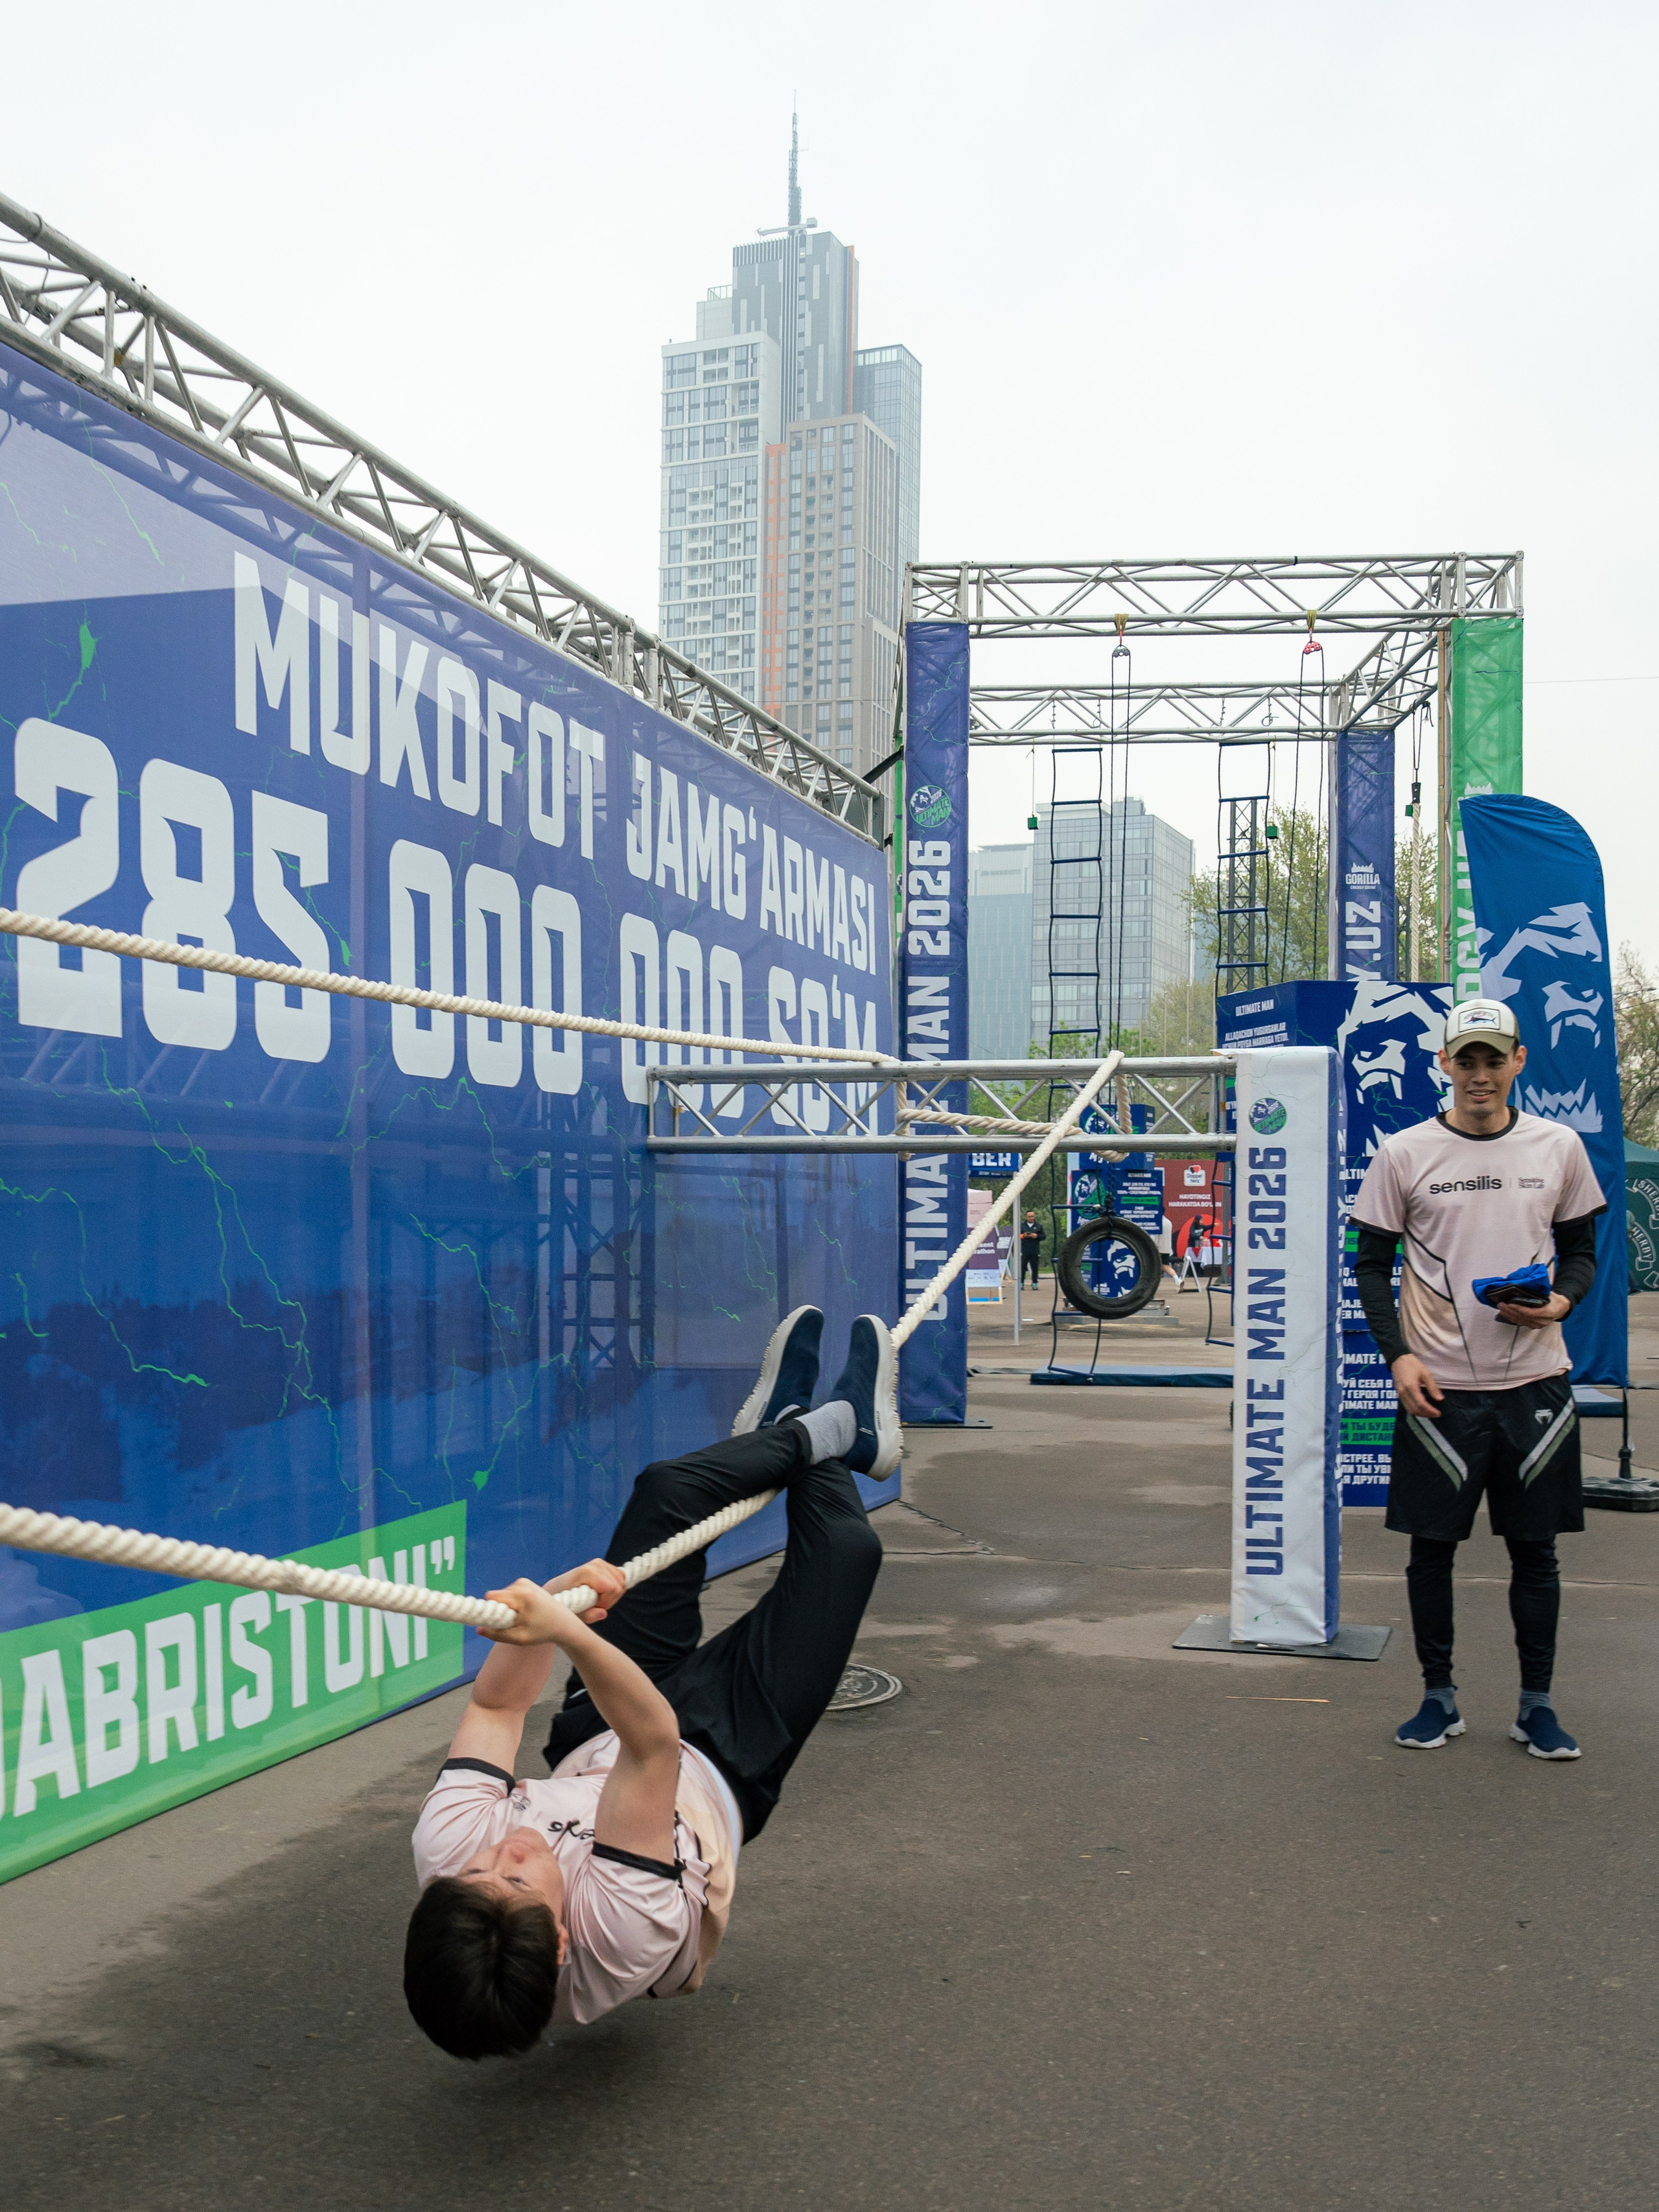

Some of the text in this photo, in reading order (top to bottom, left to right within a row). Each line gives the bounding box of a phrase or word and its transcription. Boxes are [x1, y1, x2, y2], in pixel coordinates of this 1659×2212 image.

[235, 550, 604, 861] MUKOFOT
[1345, 873, 1381, 885] GORILLA
[908, 841, 951, 956] 2026
[14, 717, 331, 1063] 285
[389, 838, 583, 1095] 000
[620, 912, 745, 1119] 000
[1235, 999, 1274, 1016] ULTIMATE MAN
[1430, 1176, 1502, 1194] sensilis
[1631, 1226, 1653, 1259] HERBY
[1246, 1147, 1286, 1576] ULTIMATE MAN 2026
[1347, 1390, 1379, 1399] ГЕРОЯ
[1358, 1379, 1384, 1388] СЕБЯ
[1386, 1379, 1393, 1388] В
[0, 1535, 456, 1817] ABRISTONI”
